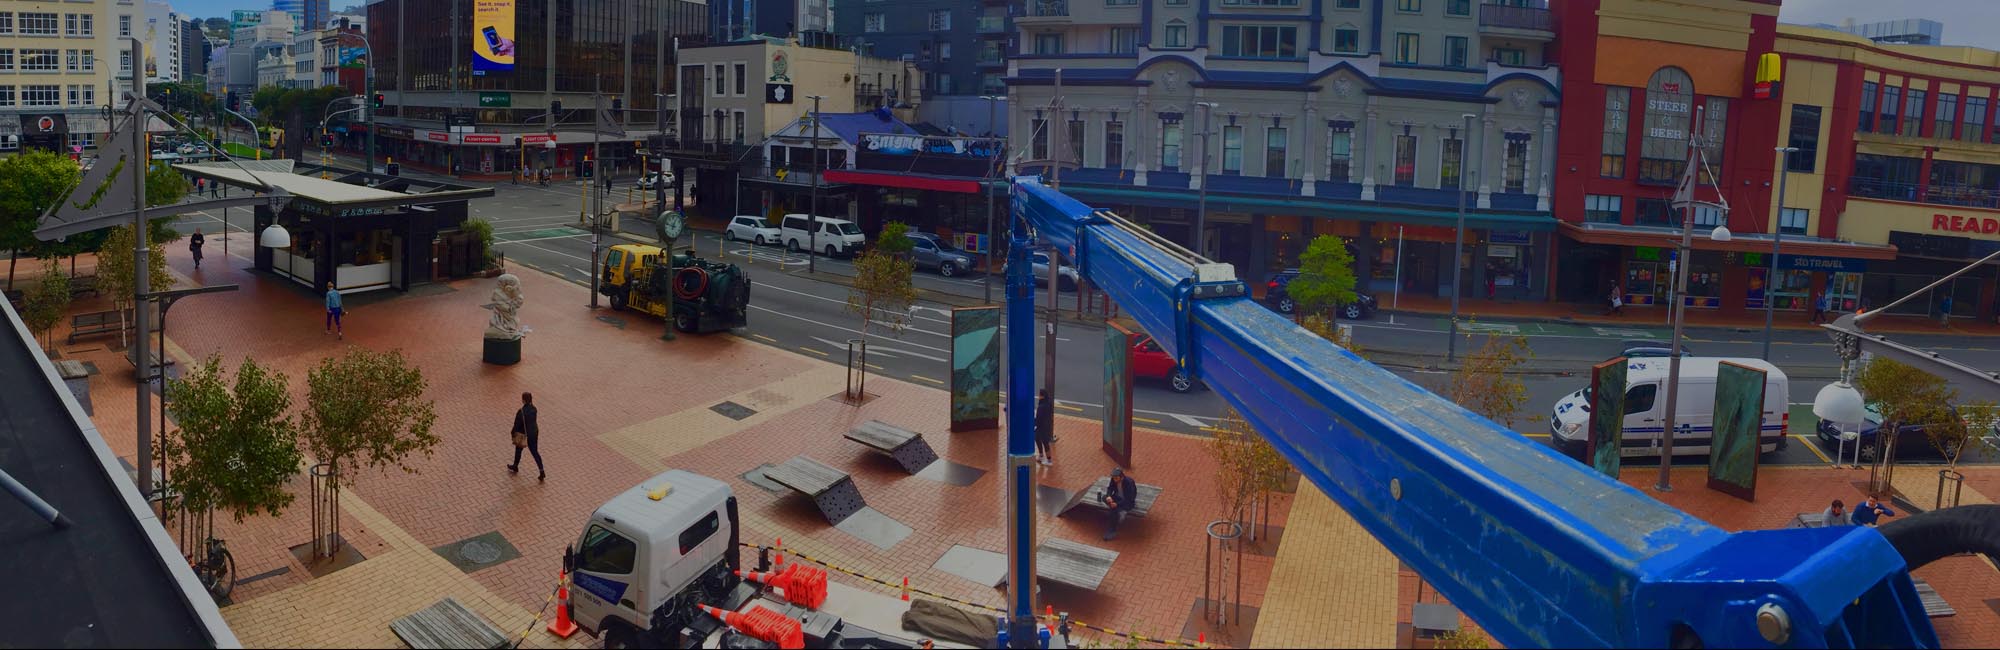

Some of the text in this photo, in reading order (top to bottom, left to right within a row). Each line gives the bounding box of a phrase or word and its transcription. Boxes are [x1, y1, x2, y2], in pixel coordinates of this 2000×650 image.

[1648, 100, 1688, 113] STEER
[1612, 101, 1621, 129] BAR
[1650, 128, 1682, 139] BEER
[865, 134, 924, 151] Enigma
[1932, 214, 2000, 234] READ
[1809, 258, 1844, 269] TRAVEL
